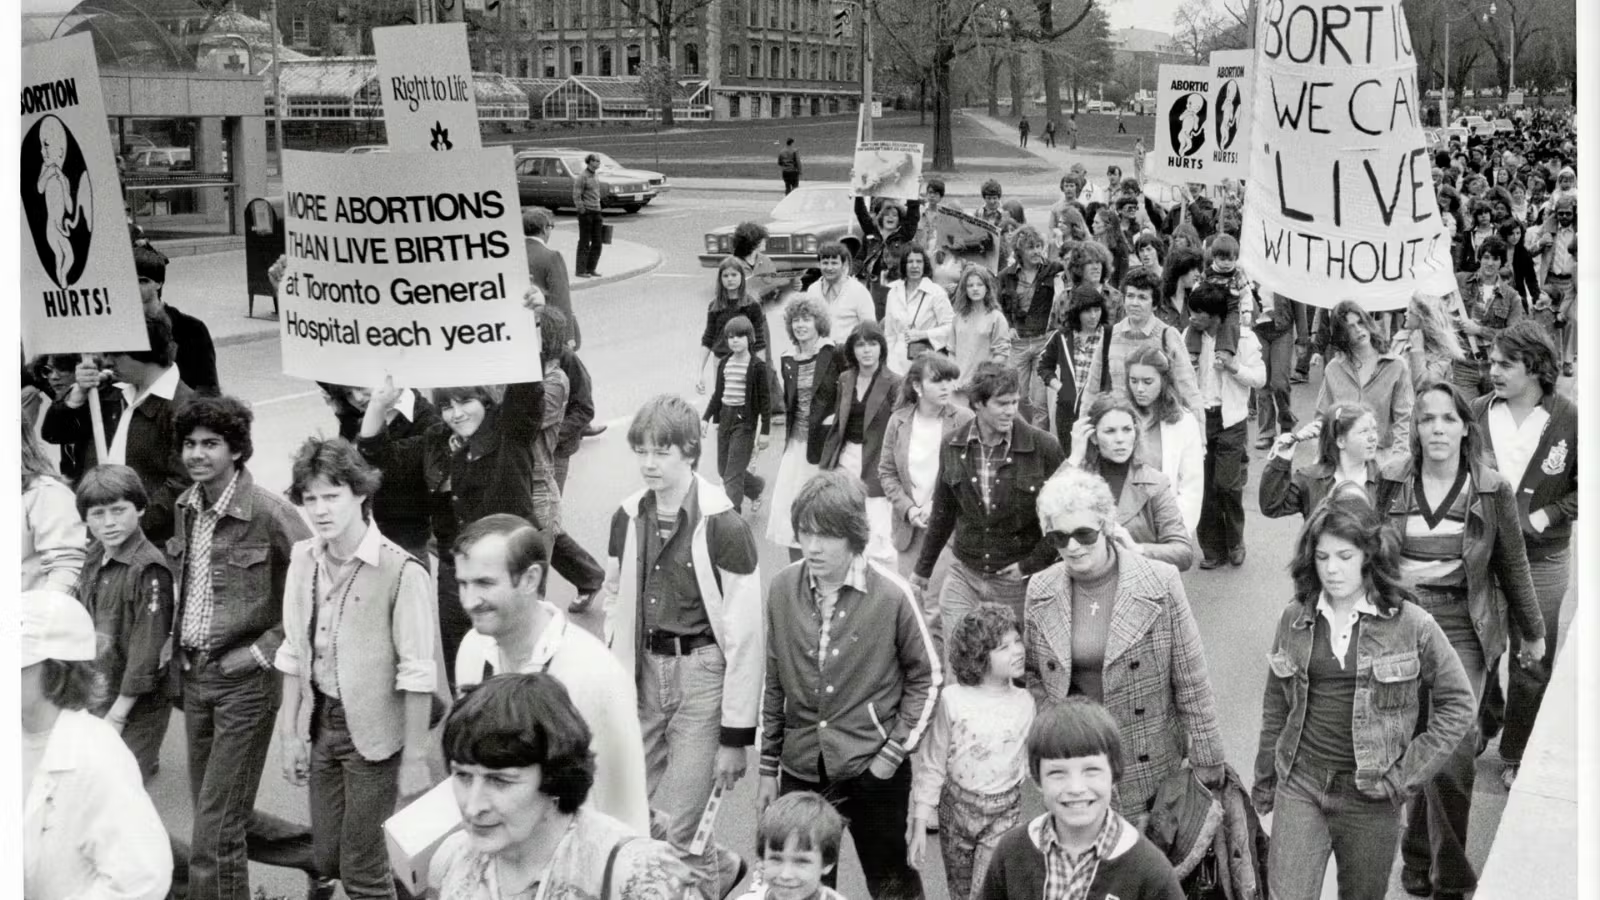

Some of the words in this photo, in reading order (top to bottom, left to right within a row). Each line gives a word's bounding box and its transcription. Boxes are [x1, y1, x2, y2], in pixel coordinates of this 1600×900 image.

[1217, 66, 1244, 78] ABORTION
[391, 74, 430, 112] Right
[431, 75, 446, 101] to
[447, 74, 468, 101] Life
[1270, 76, 1333, 134] WE
[1168, 156, 1203, 169] HURTS
[1213, 151, 1237, 163] HURTS!
[287, 191, 327, 222] MORE
[335, 190, 504, 224] ABORTIONS
[288, 230, 328, 262] THAN
[333, 236, 389, 264] LIVE
[395, 230, 510, 264] BIRTHS
[1263, 220, 1424, 283] WITHOUT
[43, 287, 112, 318] HURTS!
[286, 272, 299, 296] at
[303, 272, 380, 305] Toronto
[390, 272, 506, 305] General
[286, 309, 360, 347] Hospital
[366, 320, 432, 347] each
[440, 322, 511, 351] year.
